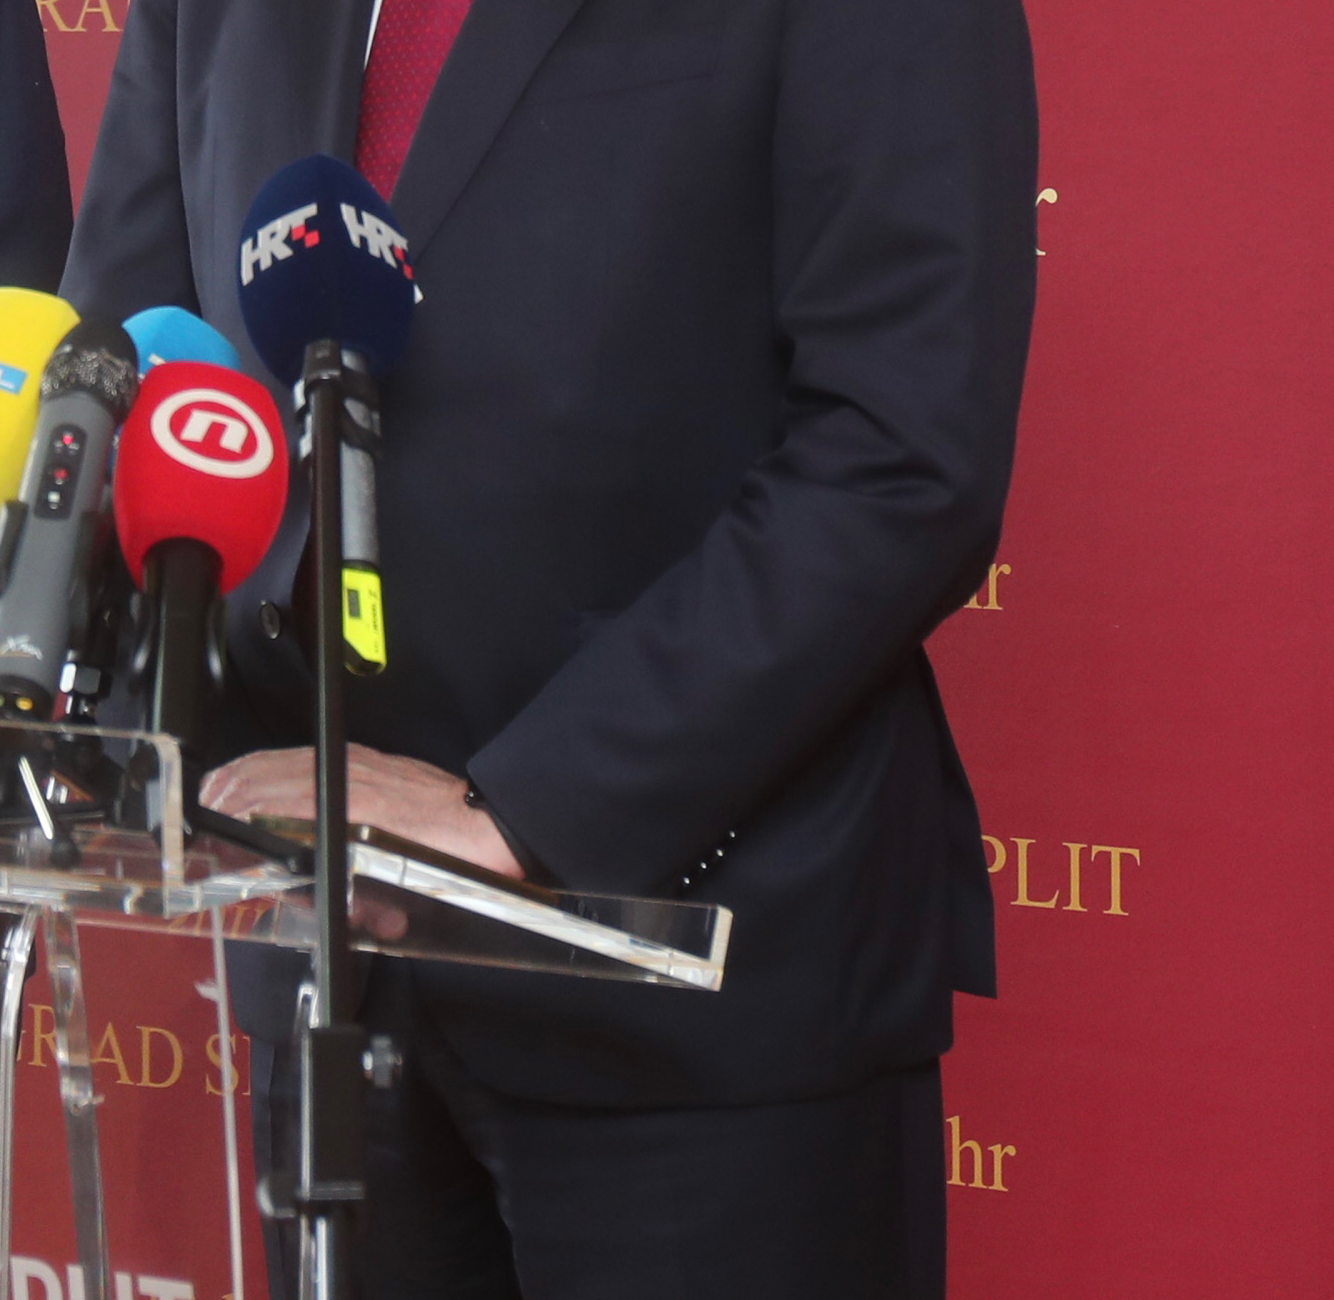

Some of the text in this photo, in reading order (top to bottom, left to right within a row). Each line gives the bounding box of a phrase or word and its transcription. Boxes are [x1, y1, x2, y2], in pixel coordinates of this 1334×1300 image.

[241, 201, 321, 287] HRT
[981, 834, 1141, 916] LIT
[17, 1004, 184, 1089] RAD
